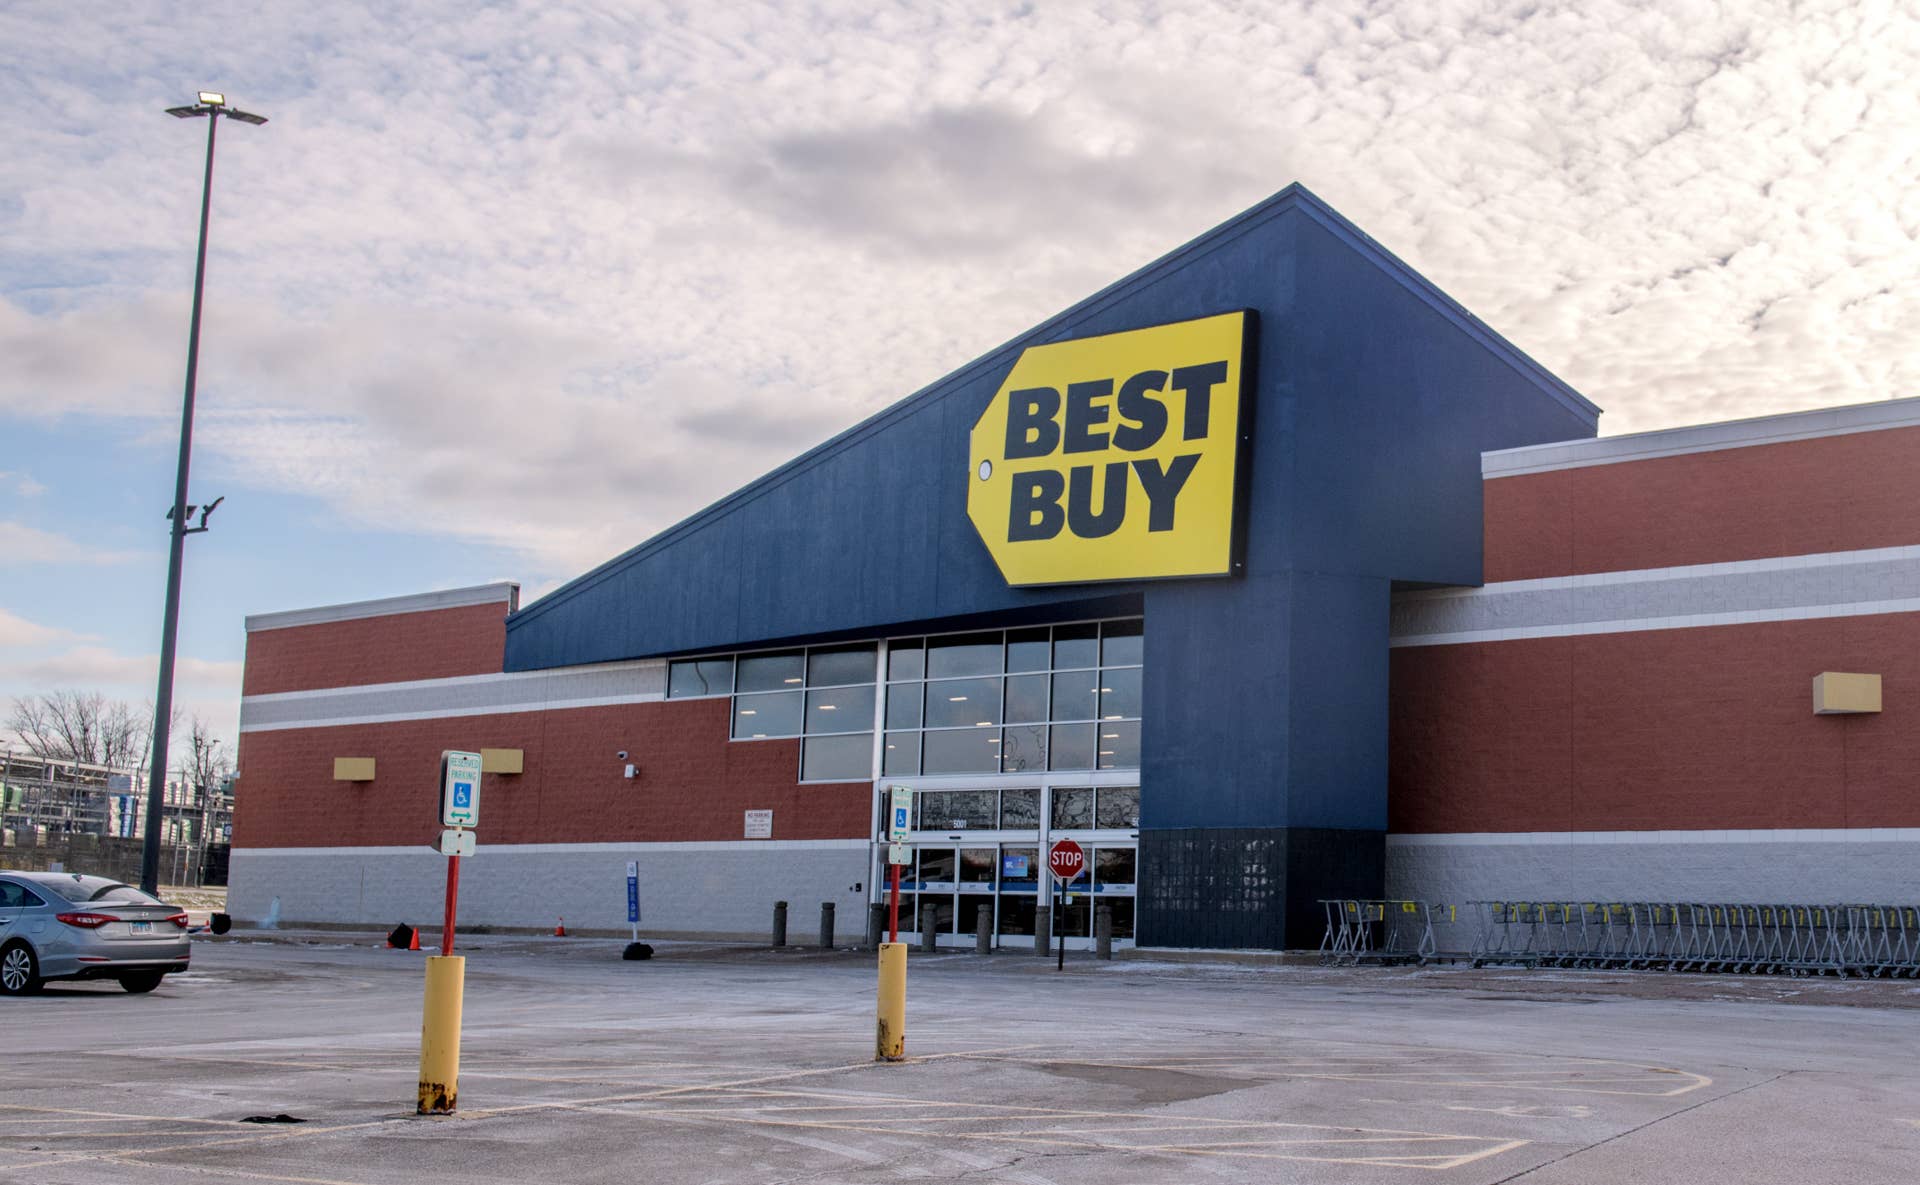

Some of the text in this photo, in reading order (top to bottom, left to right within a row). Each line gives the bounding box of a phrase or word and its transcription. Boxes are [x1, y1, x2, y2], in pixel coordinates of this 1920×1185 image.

[1004, 360, 1228, 460] BEST
[1007, 453, 1203, 543] BUY
[451, 770, 476, 781] PARKING
[1052, 851, 1082, 866] STOP
